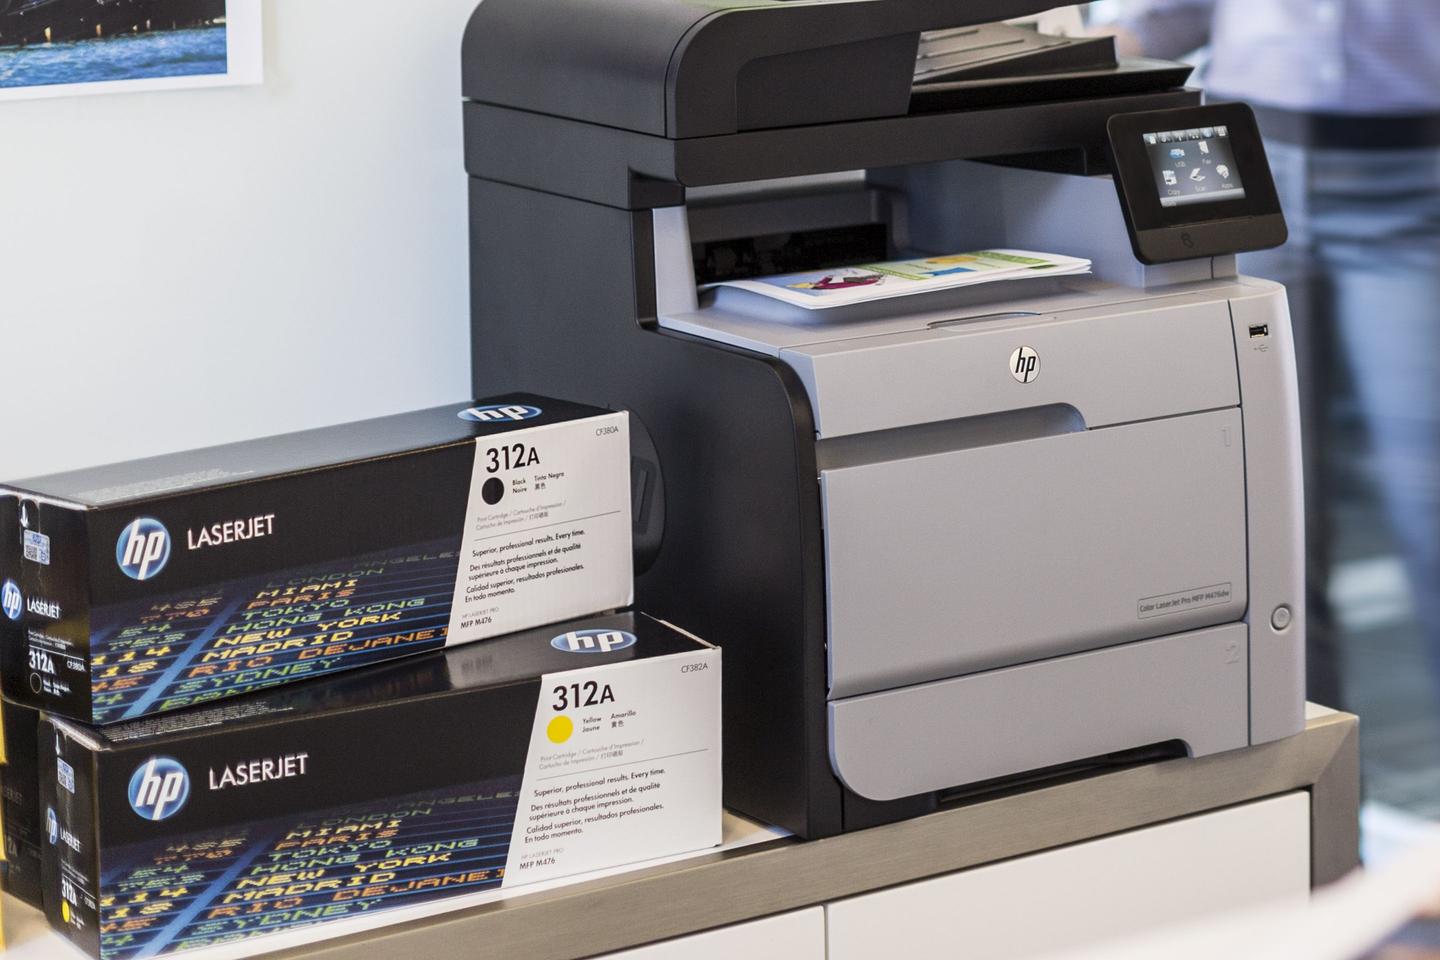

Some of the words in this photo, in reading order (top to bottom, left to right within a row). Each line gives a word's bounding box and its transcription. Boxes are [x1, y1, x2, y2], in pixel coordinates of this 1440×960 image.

[1015, 347, 1037, 383] hp
[467, 405, 529, 421] hp
[595, 425, 619, 437] CF380A
[486, 443, 540, 474] 312A
[512, 478, 527, 486] Black
[512, 486, 527, 494] Noire
[122, 518, 166, 581] hp
[186, 514, 276, 551] LASERJET
[472, 547, 499, 558] Superior,
[499, 539, 534, 553] professional
[535, 535, 554, 544] results.
[555, 531, 571, 541] Every
[571, 528, 585, 537] time.
[469, 564, 481, 572] Des
[506, 550, 547, 566] professionnels
[547, 548, 554, 556] et
[554, 546, 561, 555] de
[505, 564, 526, 575] chaque
[526, 557, 559, 571] impression.
[256, 578, 358, 599] MIAMI
[466, 583, 490, 594] Calidad
[490, 578, 516, 590] superior,
[516, 571, 545, 584] resultados
[546, 563, 585, 578] profesionales.
[3, 577, 21, 619] hp
[26, 597, 61, 620] LASERJET
[247, 588, 356, 610] PARIS
[464, 595, 473, 603] En
[473, 592, 487, 601] todo
[487, 587, 516, 599] momento.
[226, 612, 324, 634] HONG
[344, 597, 426, 618] KONG
[241, 599, 349, 620] TOKYO
[213, 627, 292, 648] NEW
[317, 611, 403, 632] YORK
[460, 620, 474, 629] MFP
[474, 617, 492, 627] M476
[201, 630, 354, 663] MADRID
[565, 631, 624, 652] hp
[28, 648, 56, 675] 312A
[188, 655, 273, 679] RIO
[681, 662, 708, 674] CF382A
[174, 656, 341, 695] SYDNEY
[552, 680, 616, 712] 312A
[582, 716, 602, 724] Yellow
[610, 709, 637, 720] Amarillo
[582, 724, 600, 733] Jaune
[135, 757, 185, 821] hp
[208, 752, 309, 791] LASERJET
[533, 786, 564, 798] Superior,
[564, 777, 606, 793] professional
[606, 774, 630, 784] results.
[630, 770, 649, 781] Every
[649, 767, 666, 776] time.
[530, 803, 543, 812] Des
[573, 787, 621, 804] professionnels
[621, 786, 628, 794] et
[628, 784, 637, 793] de
[571, 803, 596, 816] chaque
[596, 796, 634, 810] impression.
[285, 819, 403, 840] MIAMI
[526, 823, 553, 835] Calidad
[553, 818, 584, 831] superior,
[584, 811, 619, 823] resultados
[619, 802, 664, 818] profesionales.
[274, 828, 399, 851] PARIS
[524, 836, 533, 844] En
[534, 833, 550, 842] todo
[550, 828, 584, 840] momento.
[250, 853, 361, 876] HONG
[385, 837, 480, 859] KONG
[268, 839, 393, 862] TOKYO
[236, 869, 326, 890] NEW
[354, 852, 453, 874] YORK
[519, 861, 534, 871] MFP
[535, 857, 556, 868] M476
[61, 878, 78, 907] 312A
[222, 872, 397, 904] MADRID
[191, 898, 382, 935] SYDNEY
[208, 897, 303, 919] RIO
